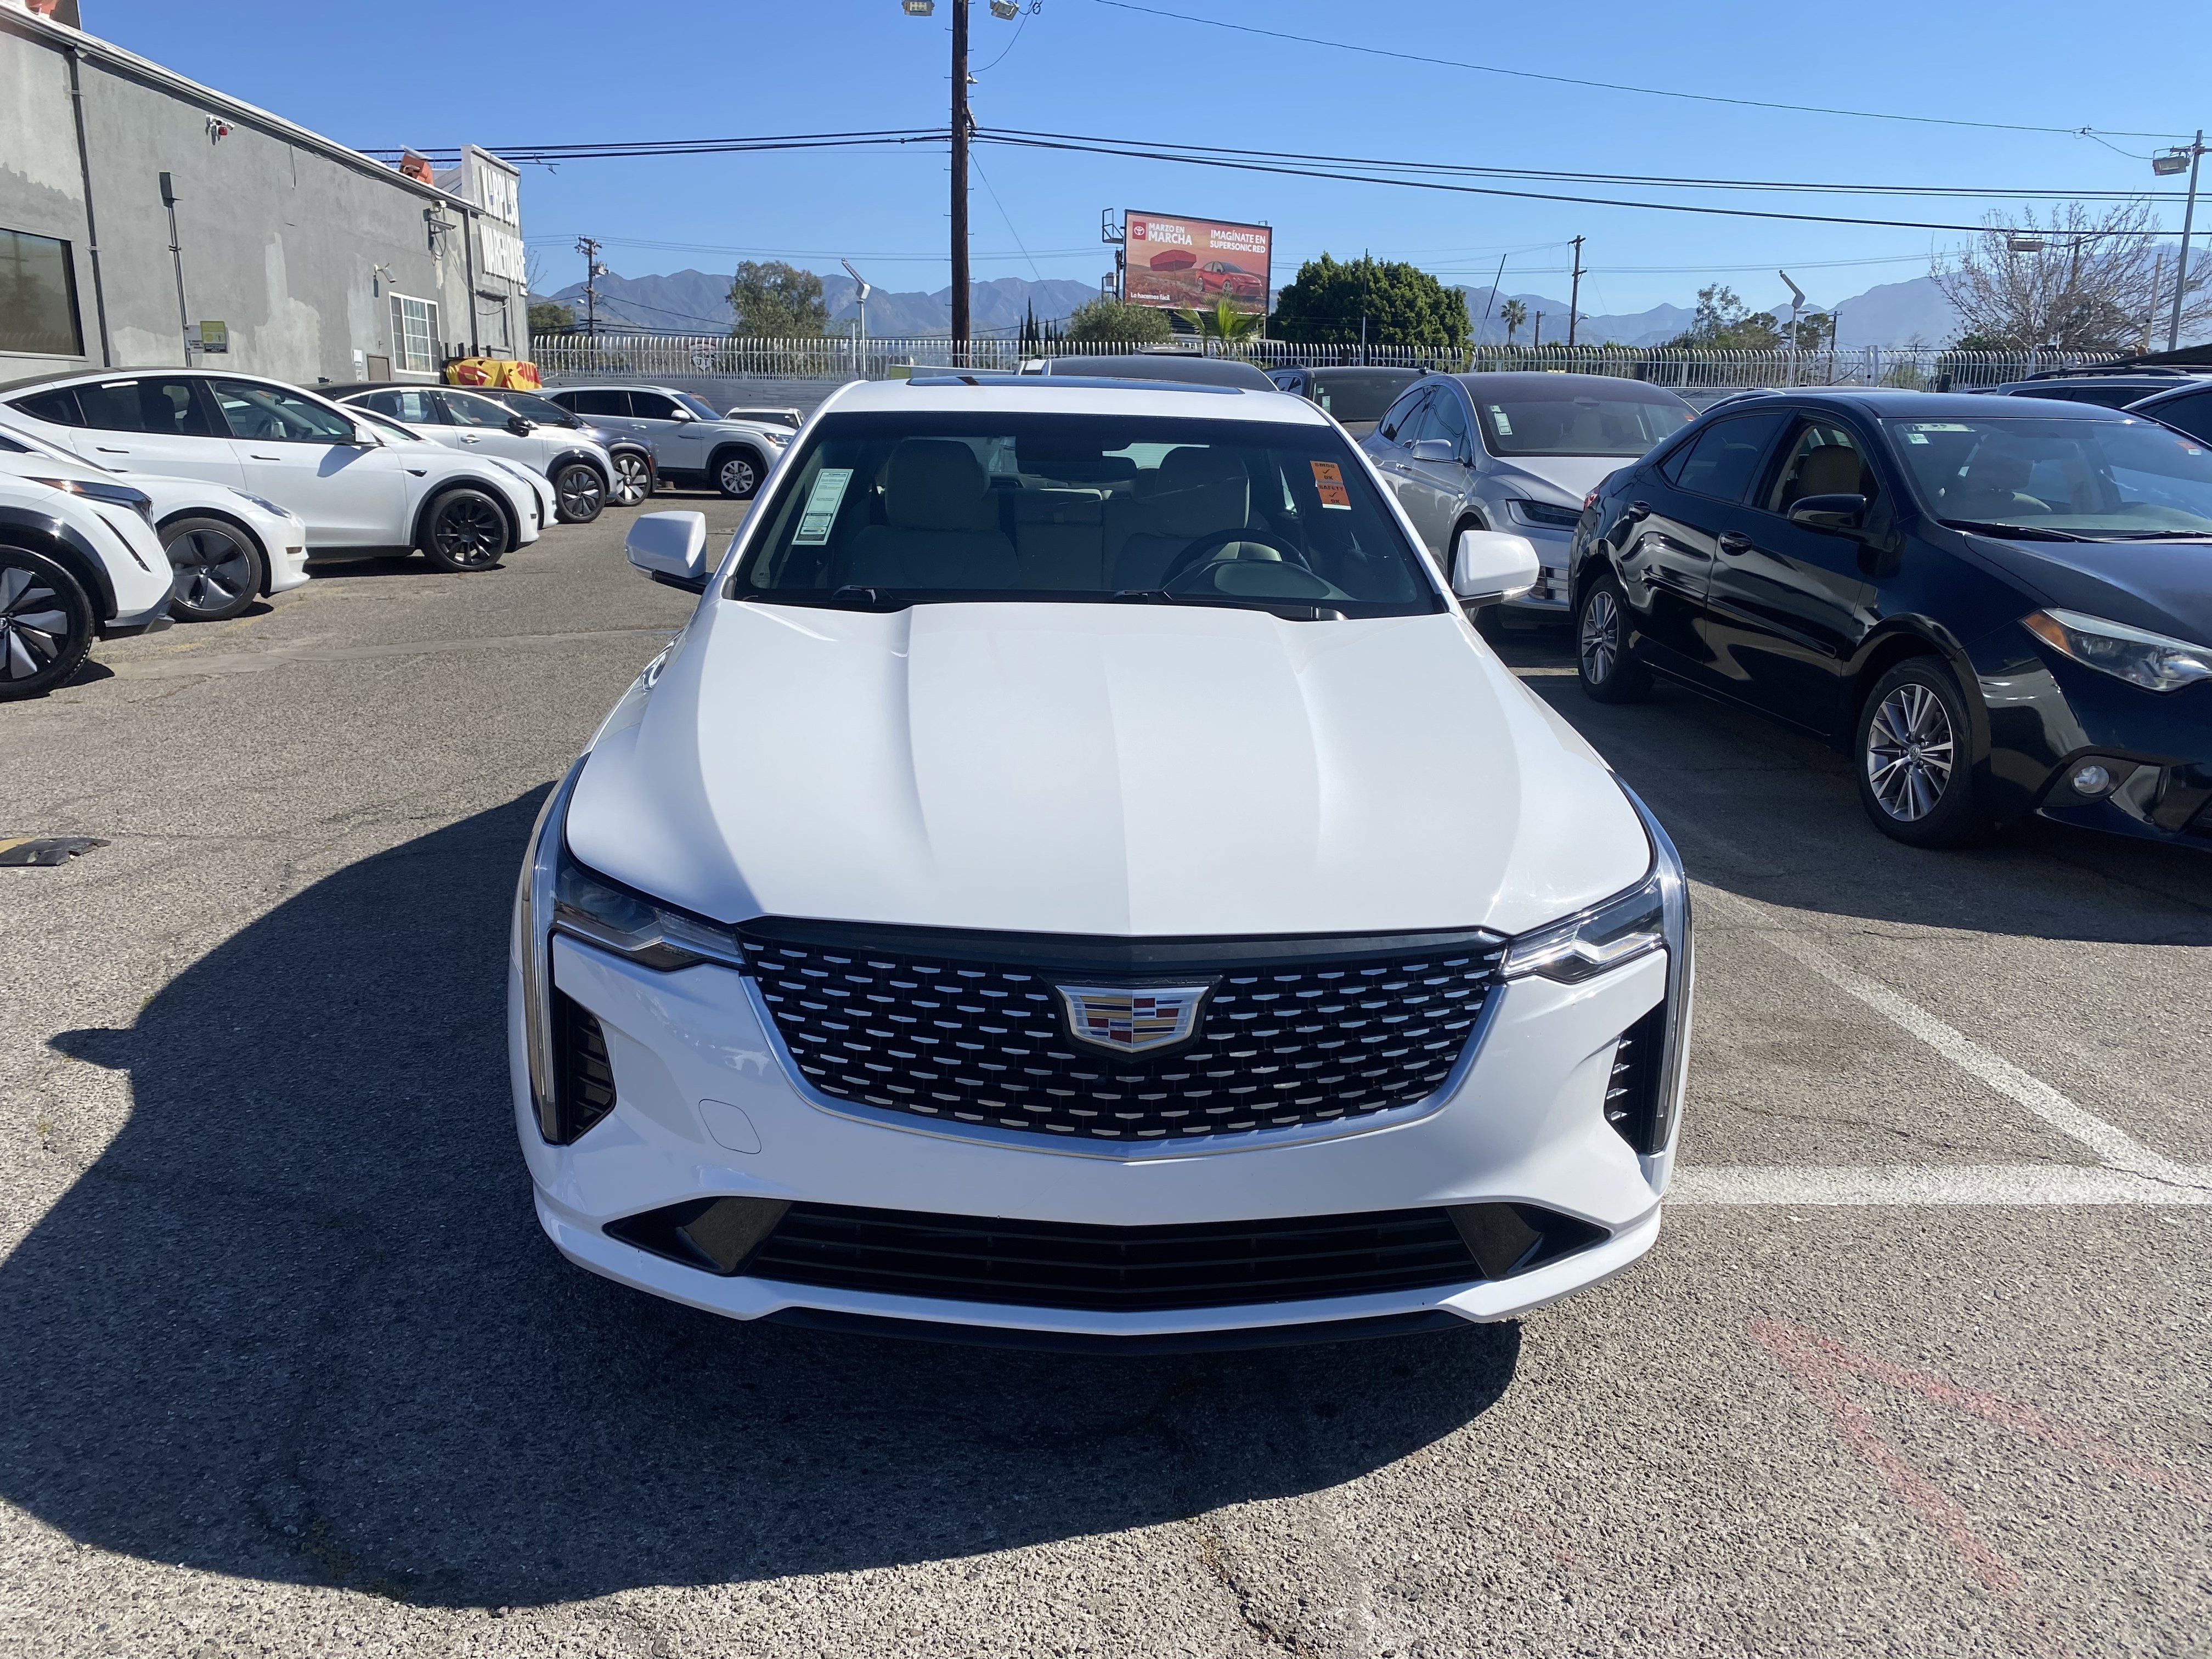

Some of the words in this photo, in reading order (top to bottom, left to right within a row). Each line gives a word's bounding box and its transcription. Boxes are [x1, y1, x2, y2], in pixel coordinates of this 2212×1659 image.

[479, 165, 519, 227] KARPLUS
[1148, 223, 1174, 232] MARZO
[1176, 225, 1185, 234] EN
[1148, 230, 1193, 245] MARCHA
[1211, 229, 1254, 243] IMAGÍNATE
[1255, 235, 1266, 245] EN
[1210, 240, 1252, 252] SUPERSONIC
[1252, 245, 1266, 253] RED
[478, 224, 527, 285] WAREHOUSE
